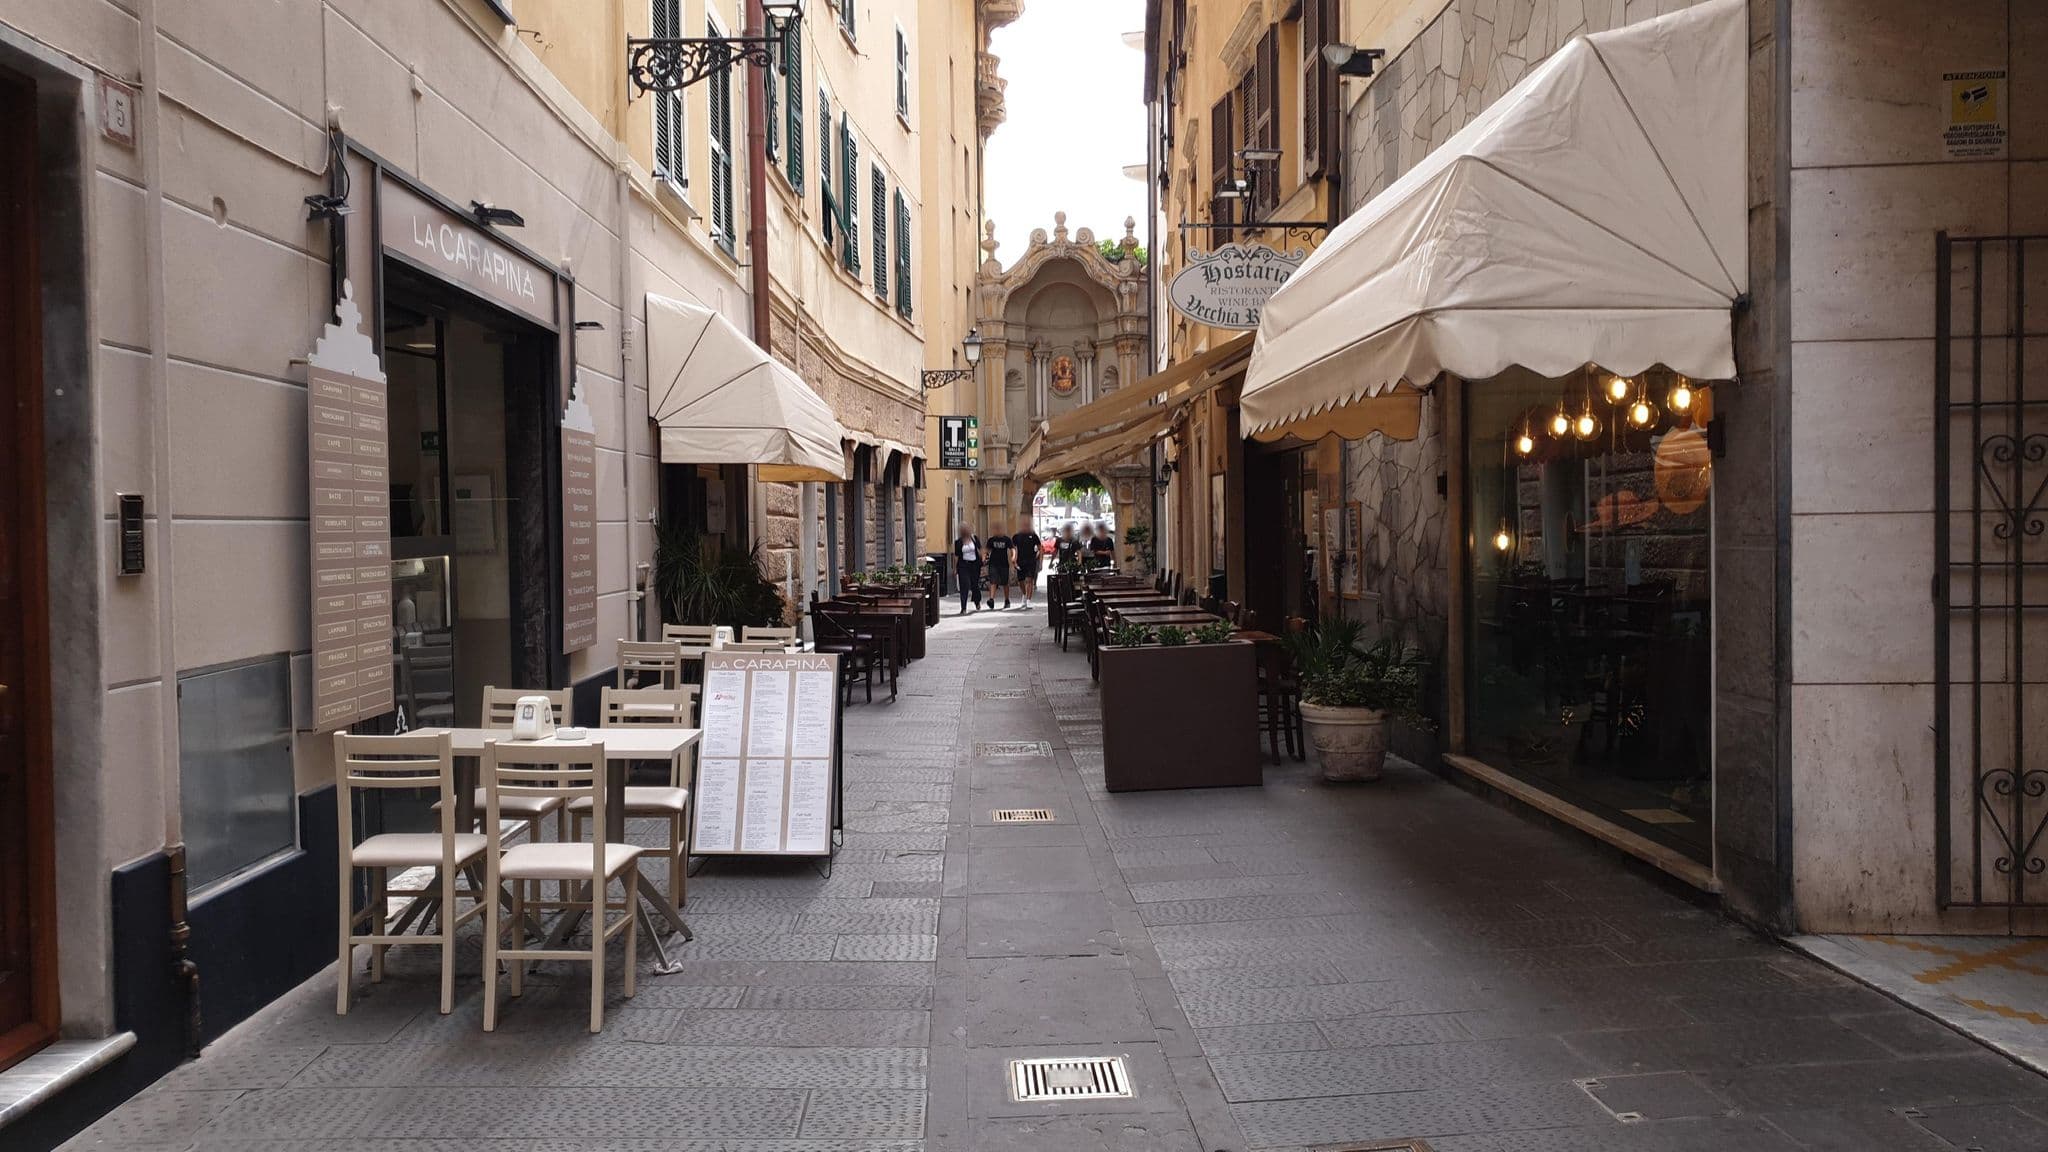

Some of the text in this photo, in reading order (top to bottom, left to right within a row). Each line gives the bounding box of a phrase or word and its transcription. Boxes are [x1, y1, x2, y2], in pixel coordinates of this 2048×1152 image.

[115, 99, 125, 128] 5
[413, 215, 536, 304] LA CARAPINA
[1201, 263, 1290, 287] Hostaria
[1186, 294, 1239, 324] Vecchia
[1218, 298, 1249, 306] WINE
[968, 420, 977, 466] LOTTO
[712, 658, 831, 670] LA CARAPINA
